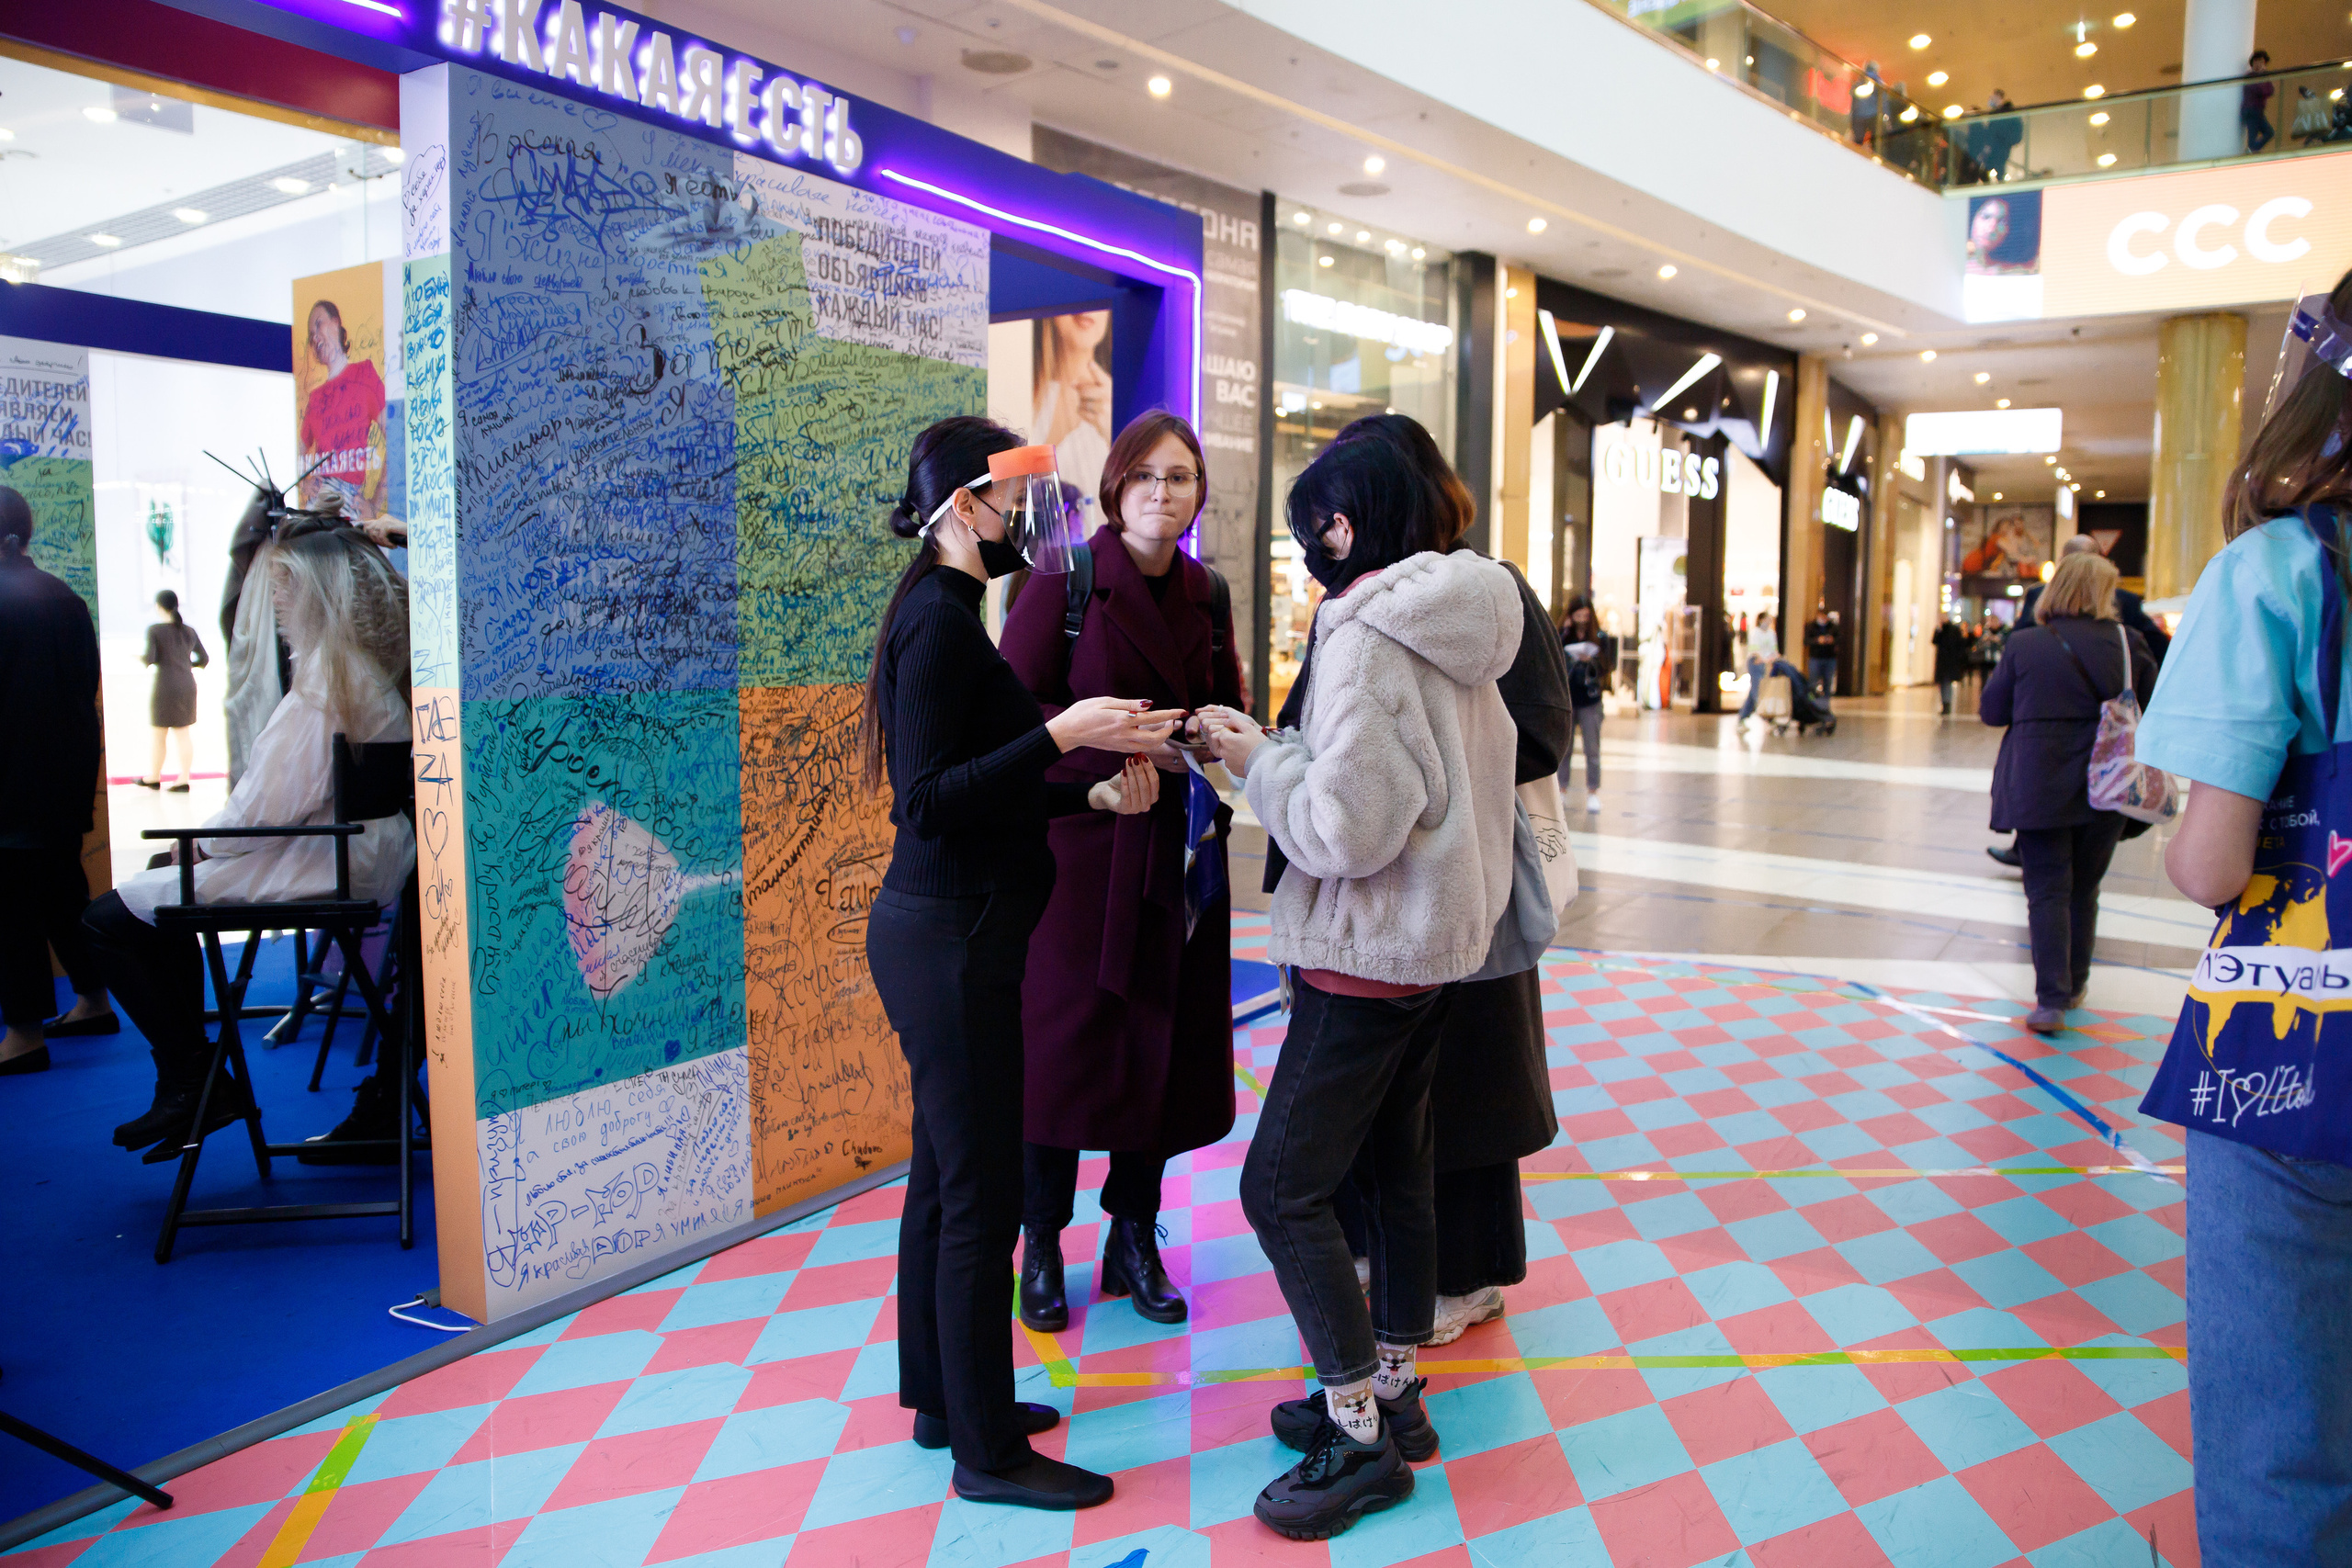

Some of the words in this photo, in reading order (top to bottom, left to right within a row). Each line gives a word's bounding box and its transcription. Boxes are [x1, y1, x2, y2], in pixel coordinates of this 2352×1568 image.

[445, 0, 864, 171] #КАКАЯЕСТЬ
[2107, 196, 2313, 276] CCC
[0, 376, 87, 402] ДИТЕЛЕЙ
[1215, 380, 1257, 409] ВАС
[1607, 442, 1720, 501] GUESS
